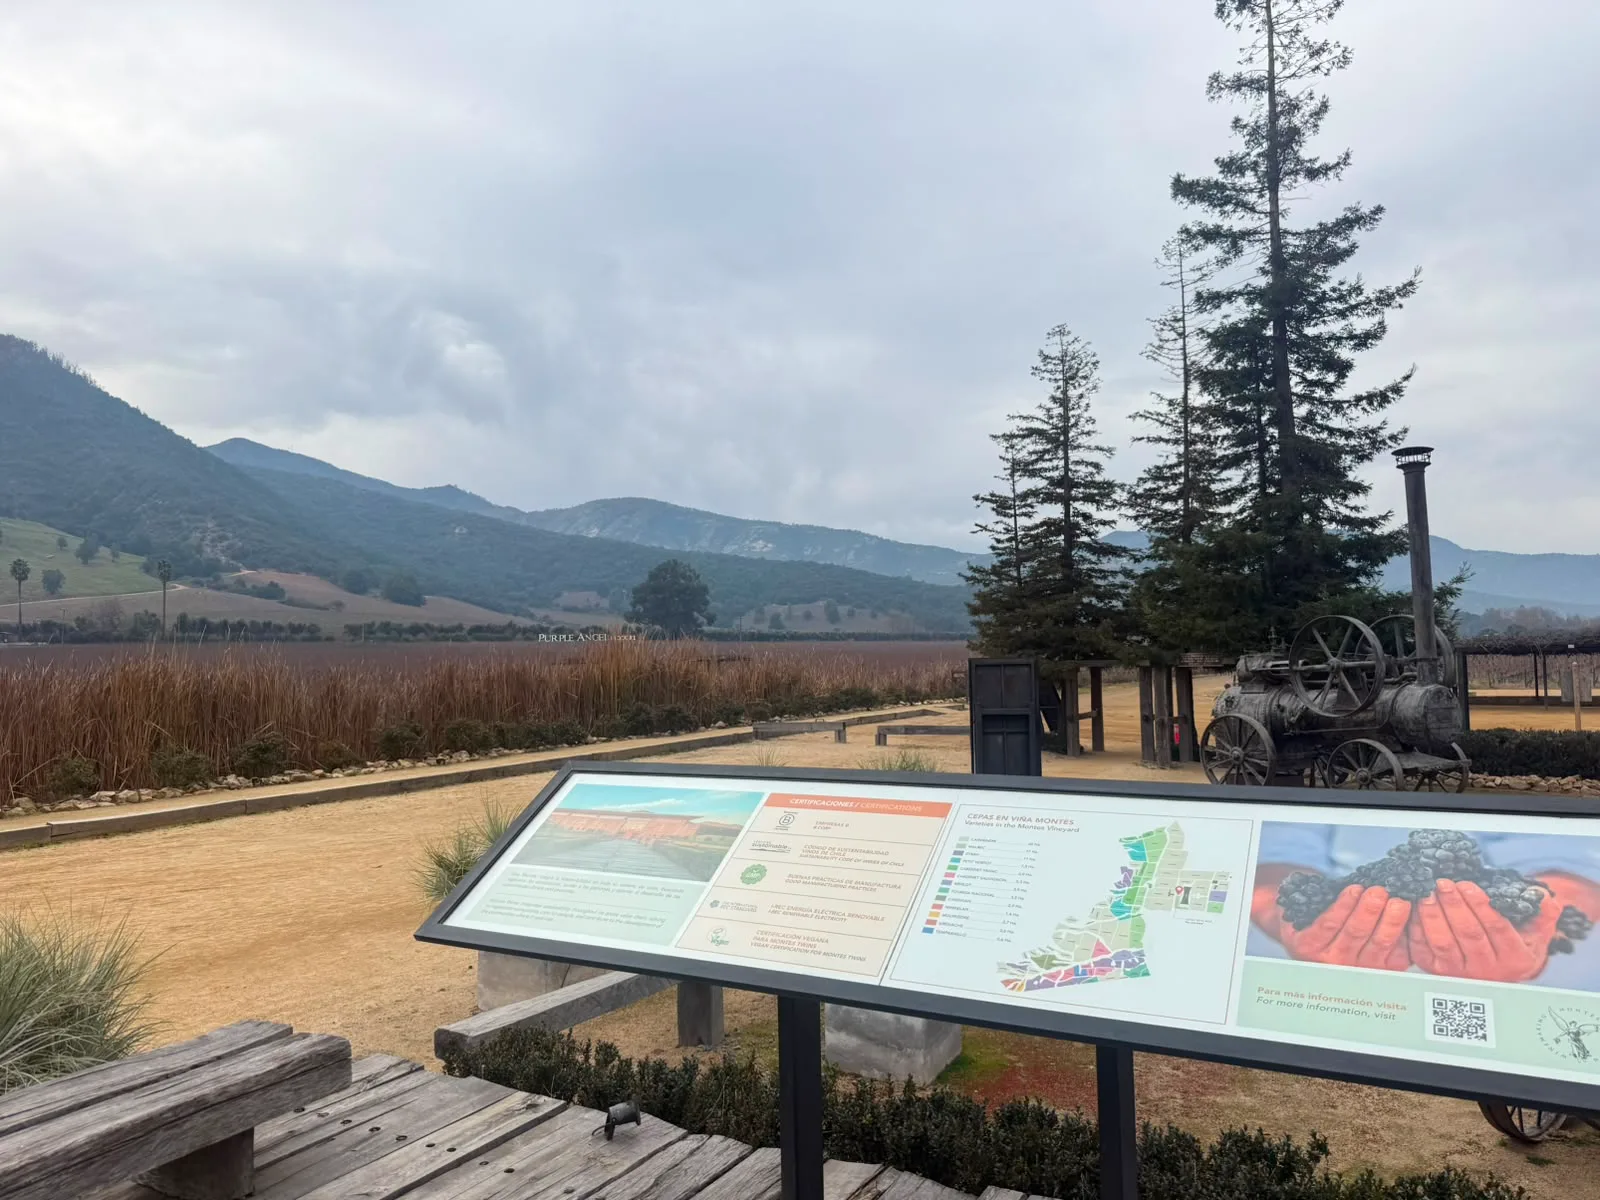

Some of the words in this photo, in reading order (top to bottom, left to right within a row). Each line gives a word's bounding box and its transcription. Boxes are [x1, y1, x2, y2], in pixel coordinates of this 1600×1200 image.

[538, 633, 574, 642] PURPLE
[789, 797, 854, 808] CERTIFICACIONES
[860, 802, 923, 813] CERTIFICATIONS
[964, 819, 994, 827] Varieties
[1017, 823, 1045, 831] Montes
[1046, 825, 1080, 833] Vineyard
[966, 812, 995, 820] CEPAS
[1035, 817, 1075, 825] MONTES
[1257, 986, 1281, 996] Para
[1308, 991, 1373, 1007] información
[1376, 1001, 1408, 1011] visita
[1256, 996, 1275, 1005] For
[1276, 999, 1303, 1009] more
[1306, 1002, 1371, 1018] information,
[1374, 1011, 1397, 1020] visit
